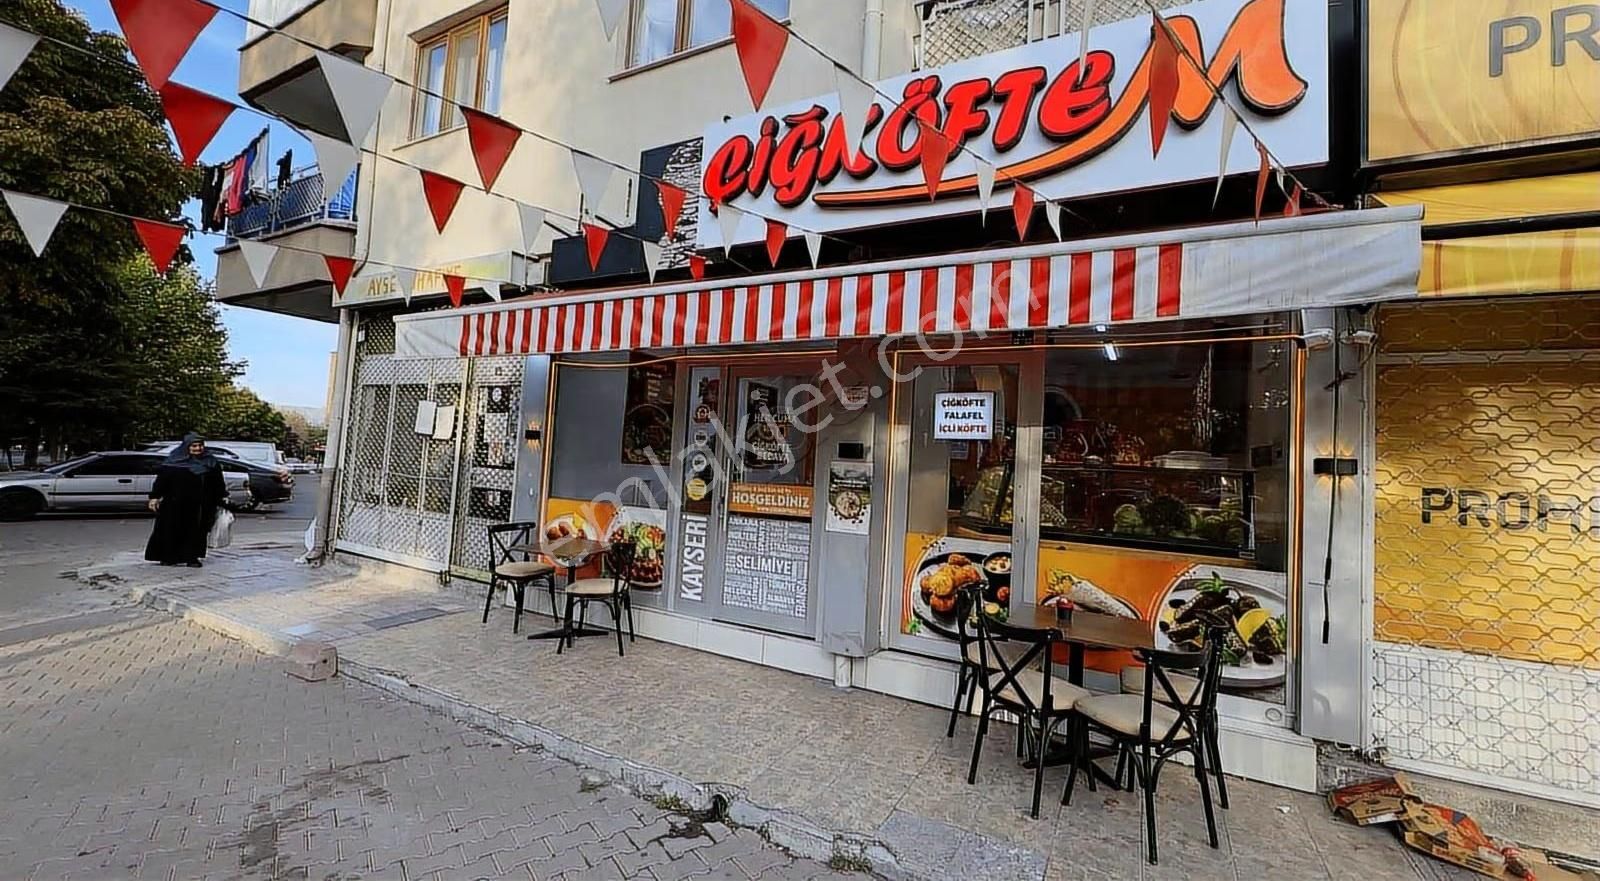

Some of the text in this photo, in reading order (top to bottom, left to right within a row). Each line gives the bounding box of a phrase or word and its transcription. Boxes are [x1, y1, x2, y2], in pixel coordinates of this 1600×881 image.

[944, 411, 984, 420] FALAFEL
[957, 422, 987, 433] KÖFTE
[731, 491, 810, 509] HOŞGELDİNİZ
[1421, 487, 1600, 536] PROM
[680, 514, 708, 602] KAYSERİ
[736, 555, 792, 576] SELİMİYE
